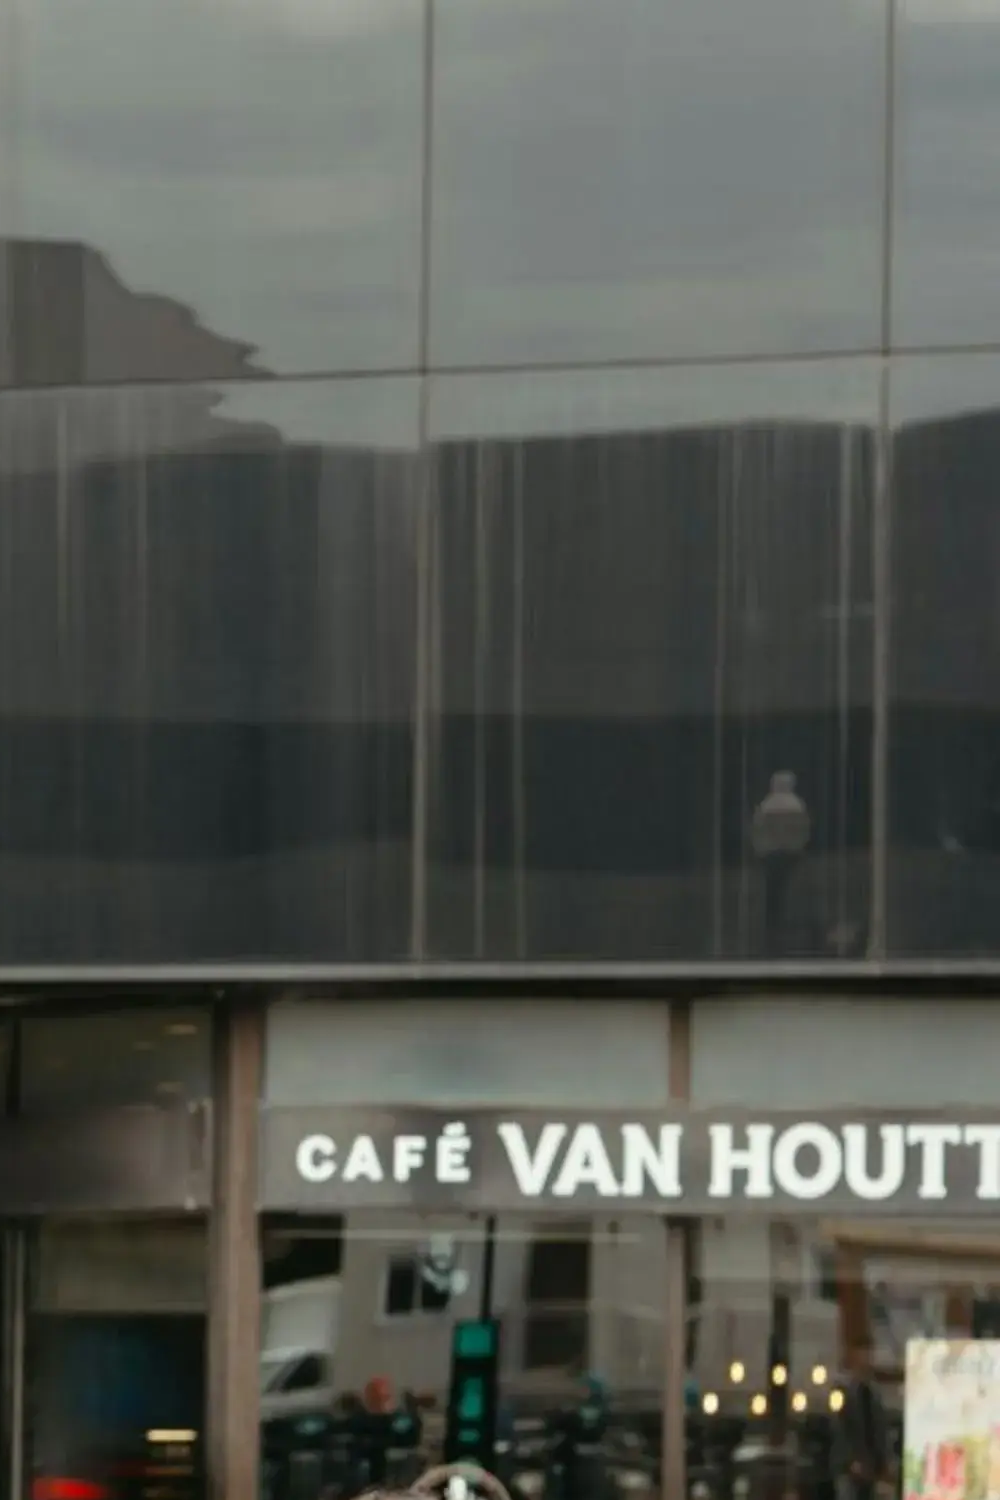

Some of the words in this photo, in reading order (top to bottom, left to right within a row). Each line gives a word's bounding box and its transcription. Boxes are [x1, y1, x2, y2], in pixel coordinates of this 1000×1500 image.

[296, 1121, 471, 1183] CAFÉ
[498, 1123, 684, 1197] VAN
[707, 1121, 1000, 1200] HOUTT
